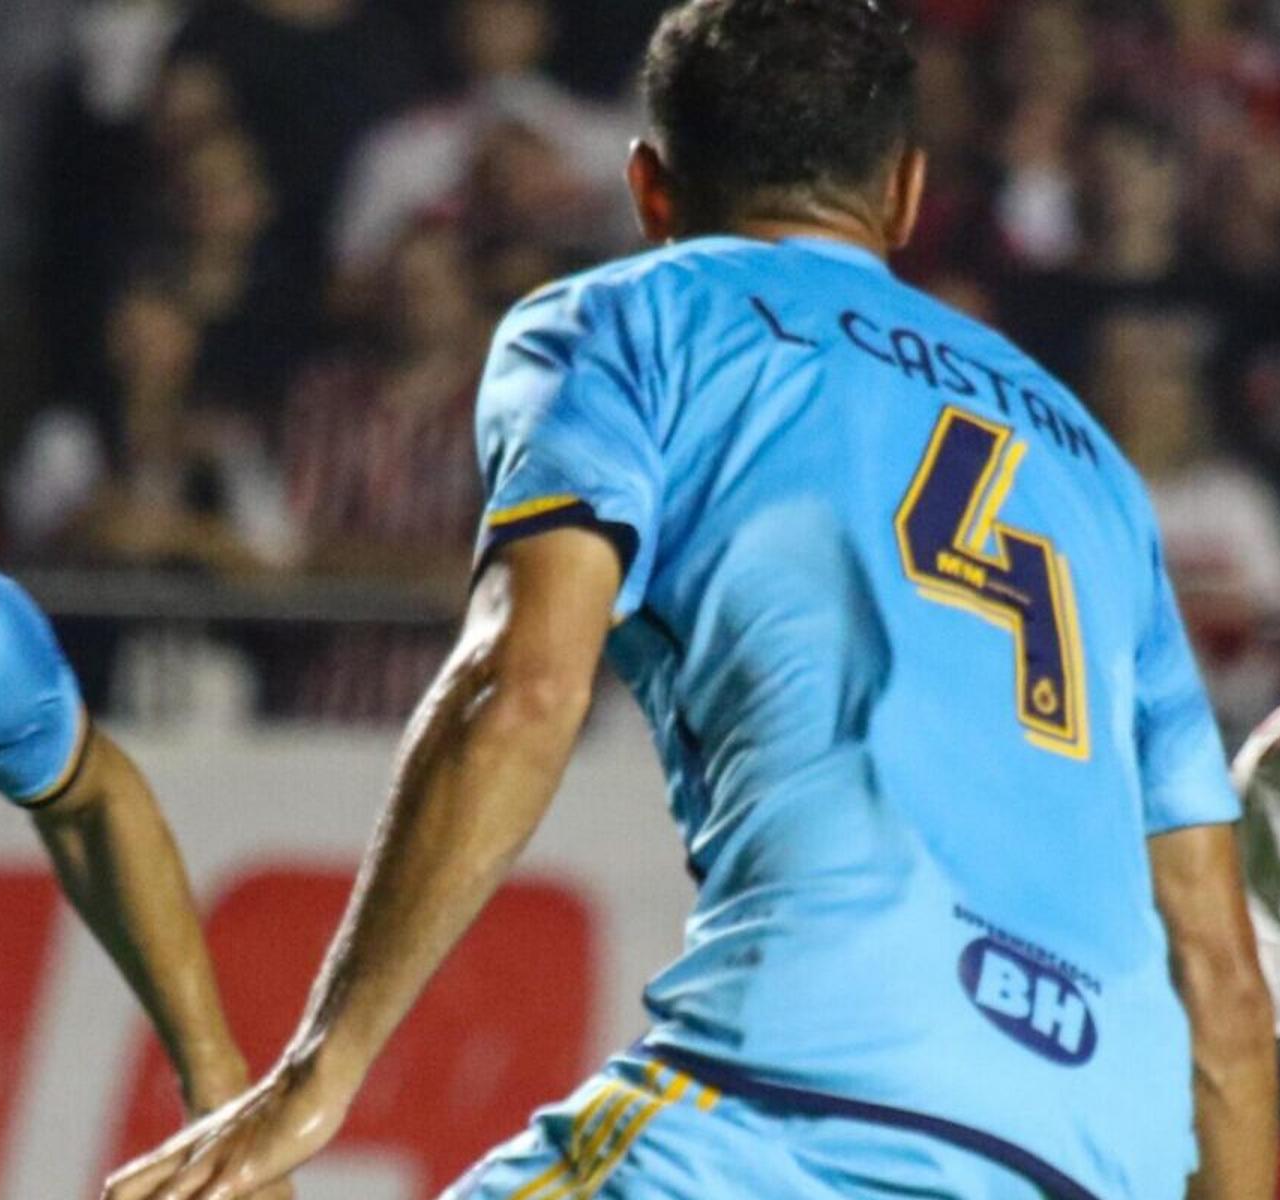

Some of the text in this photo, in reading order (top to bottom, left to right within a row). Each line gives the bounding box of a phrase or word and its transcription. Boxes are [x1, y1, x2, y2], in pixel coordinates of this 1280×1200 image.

[836, 309, 1099, 466] CASTAN
[892, 402, 1091, 761] 4
[974, 948, 1087, 1056] BH
